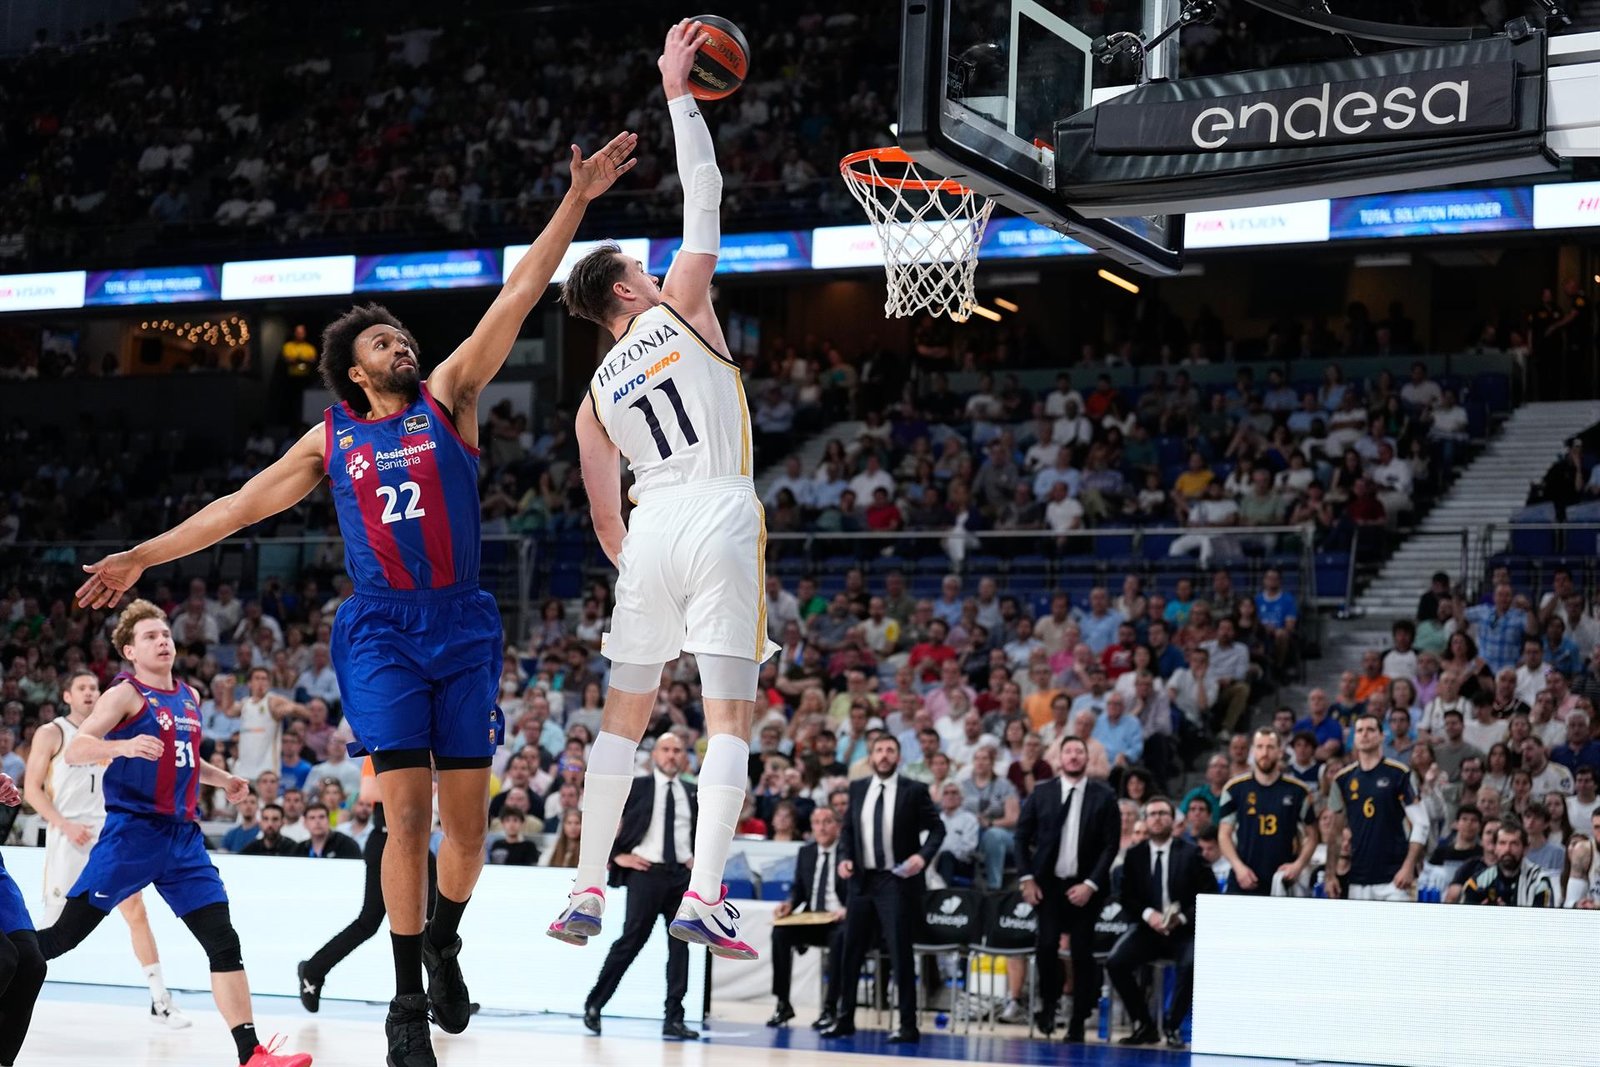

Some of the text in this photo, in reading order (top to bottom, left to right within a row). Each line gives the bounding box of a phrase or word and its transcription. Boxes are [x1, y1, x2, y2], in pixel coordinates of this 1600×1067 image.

[1191, 80, 1469, 149] endesa
[1360, 202, 1501, 225] TOTAL SOLUTION PROVIDER
[597, 324, 679, 387] HEZONJA
[613, 351, 681, 404] AUTOHERO
[628, 377, 700, 460] 11
[375, 440, 437, 461] Assistència
[376, 455, 421, 472] Sanitària
[376, 481, 426, 525] 22
[174, 740, 195, 768] 31
[90, 774, 95, 793] 1
[1363, 797, 1375, 818] 6
[1258, 814, 1278, 835] 13
[926, 912, 969, 928] Unicaja
[1094, 921, 1129, 935] nicaja
